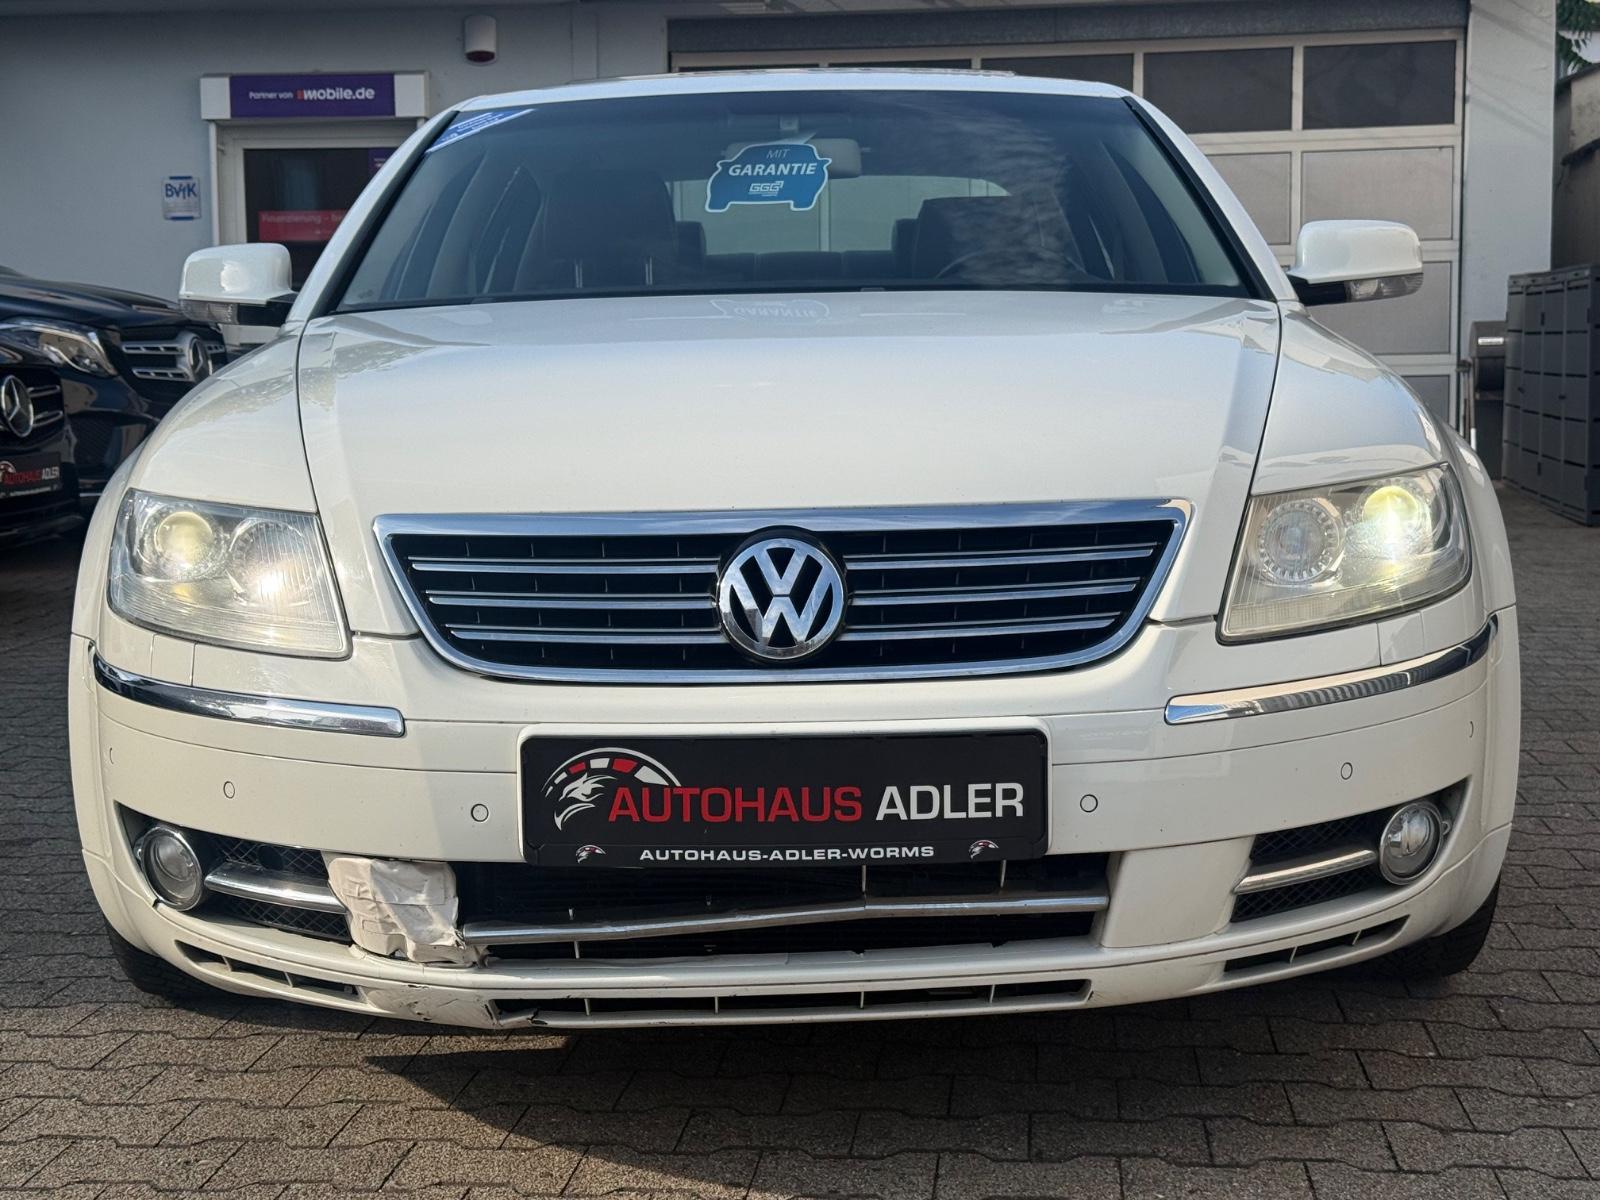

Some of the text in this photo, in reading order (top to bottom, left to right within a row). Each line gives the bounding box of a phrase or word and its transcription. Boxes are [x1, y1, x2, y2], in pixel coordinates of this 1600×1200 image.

[249, 87, 376, 100] Partner von mobile.de
[766, 148, 790, 159] MIT
[728, 162, 818, 176] GARANTIE
[608, 782, 1025, 823] AUTOHAUS ADLER
[639, 846, 935, 862] AUTOHAUS-ADLER-WORMS
